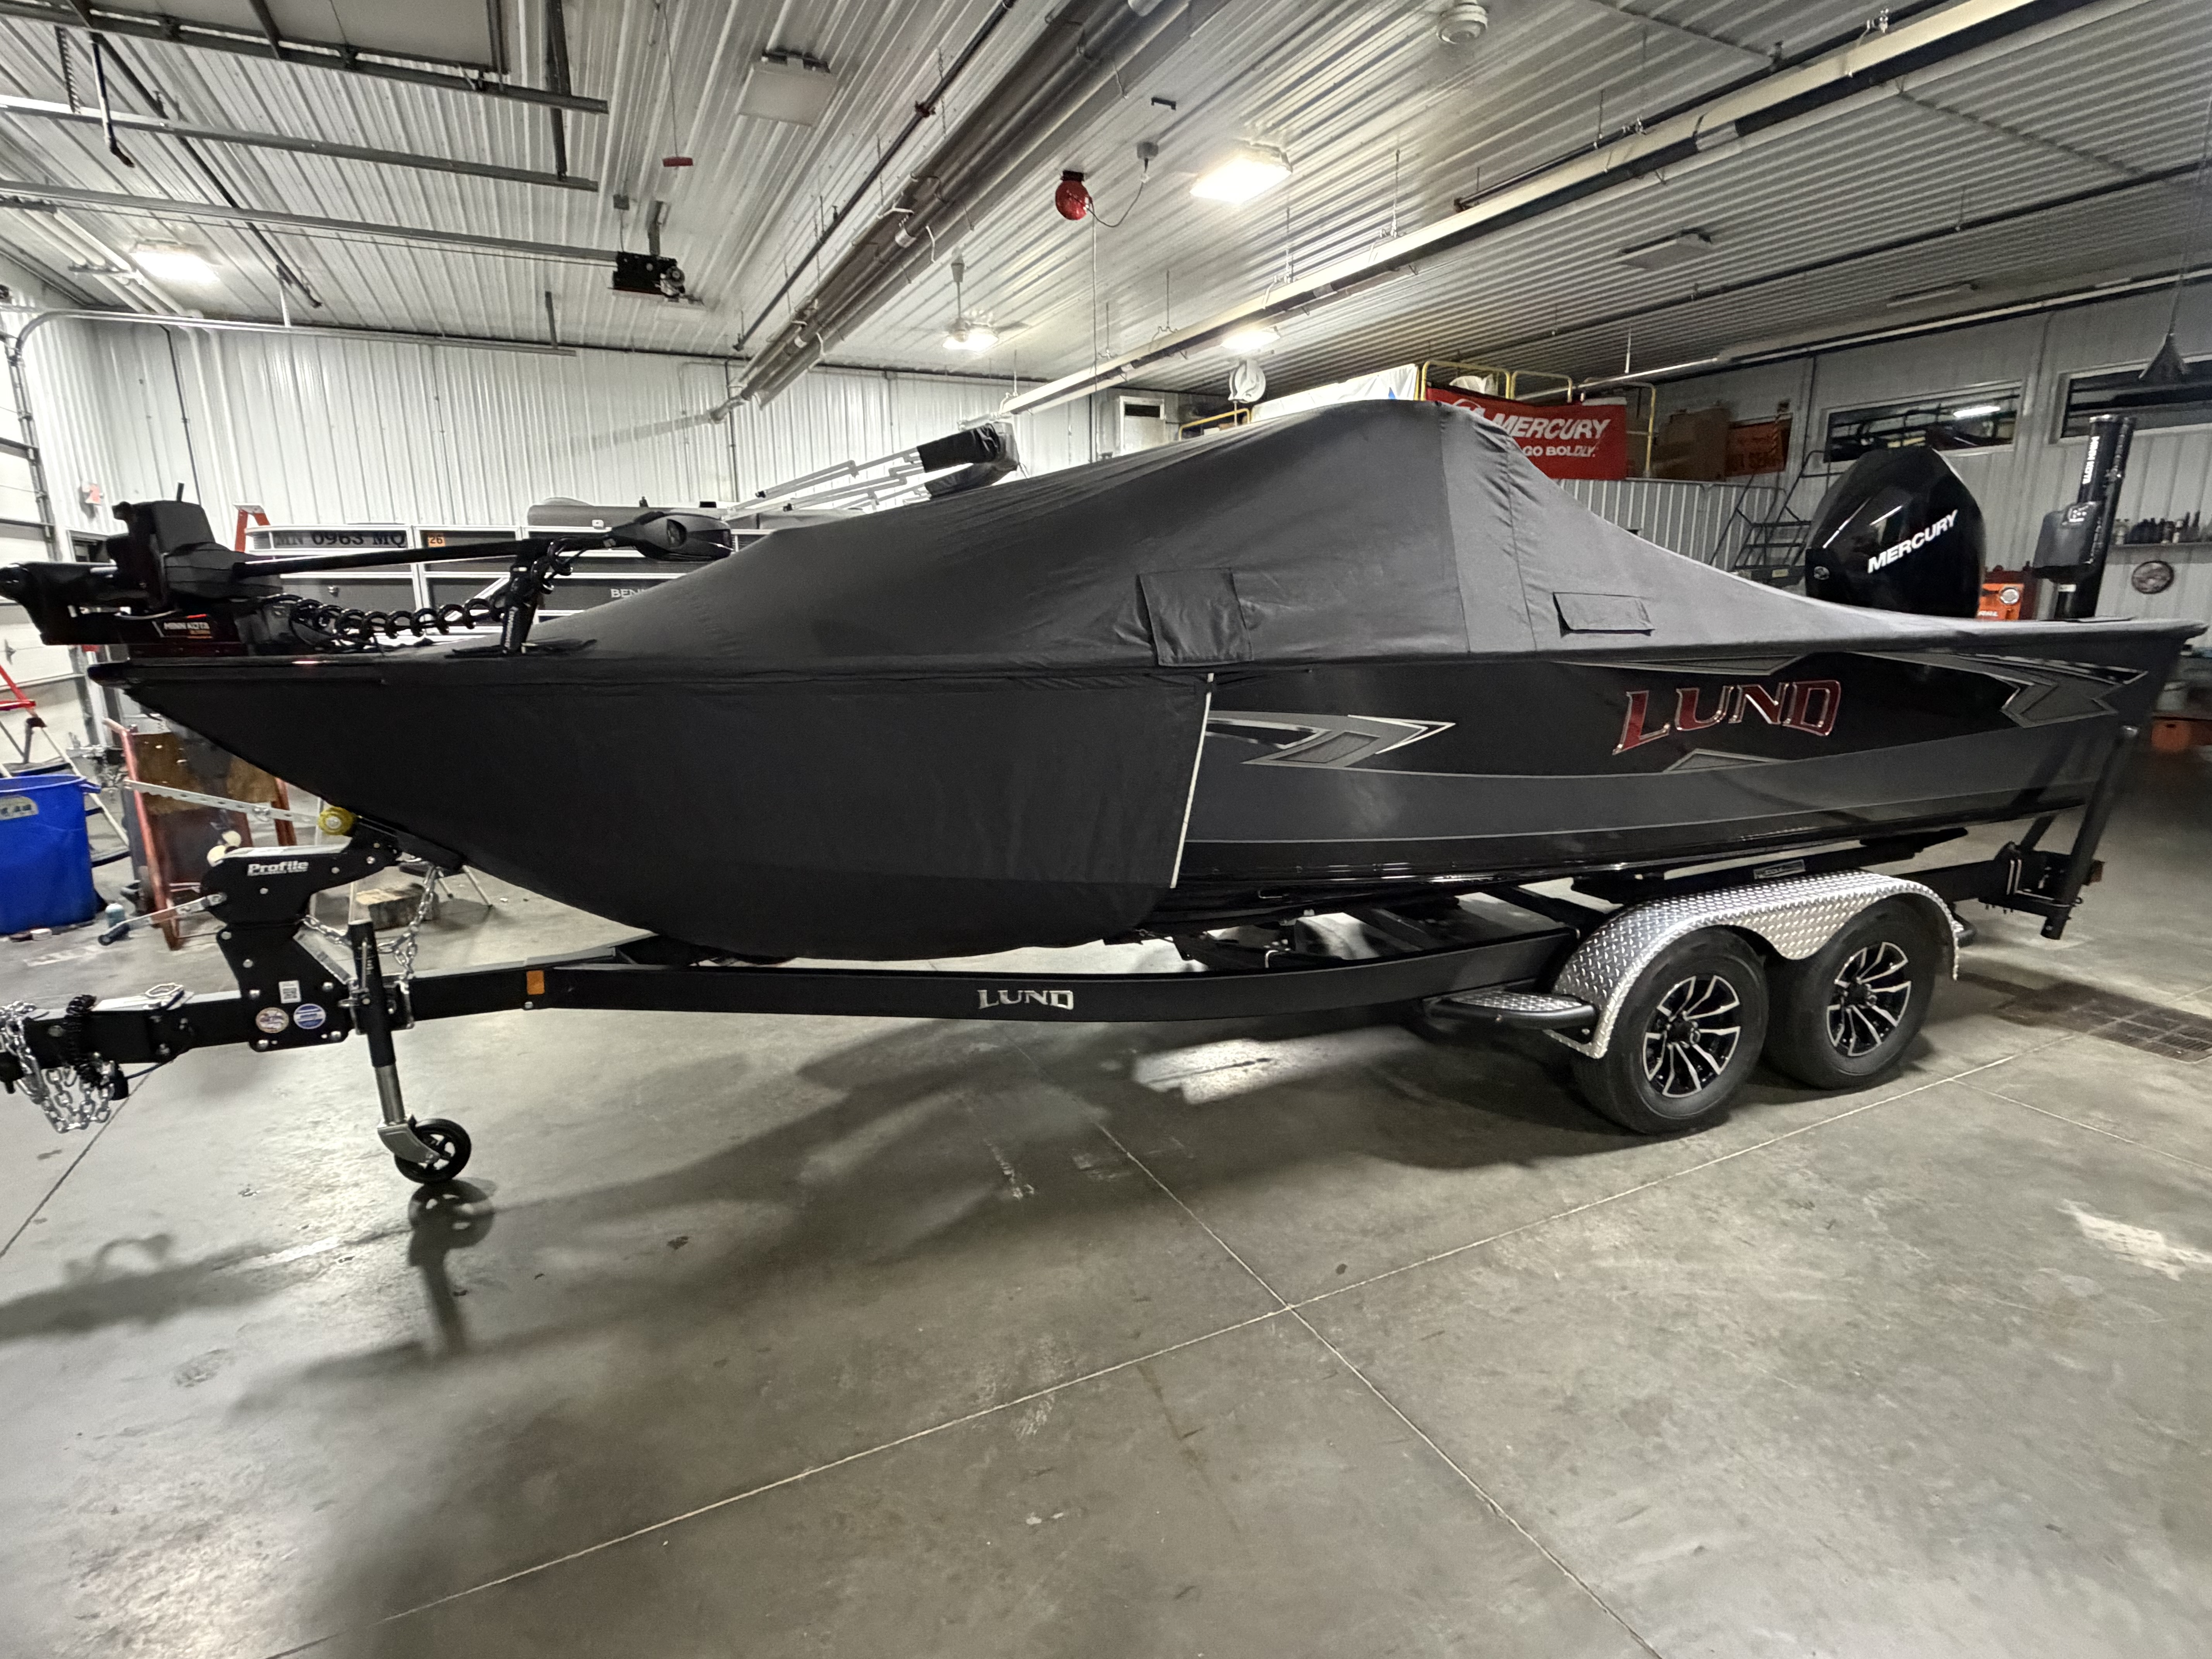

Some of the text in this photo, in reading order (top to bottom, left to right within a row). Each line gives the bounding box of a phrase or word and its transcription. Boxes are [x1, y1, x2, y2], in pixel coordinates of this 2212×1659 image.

[1492, 413, 1611, 440] MERCURY
[1524, 445, 1543, 457] GO
[311, 531, 364, 545] 0963
[429, 535, 443, 544] 26
[1867, 509, 1958, 574] MERCURY
[610, 588, 645, 598] BEN
[1612, 680, 1841, 756] LUND
[247, 860, 309, 876] Profile
[977, 989, 1073, 1010] LUND
